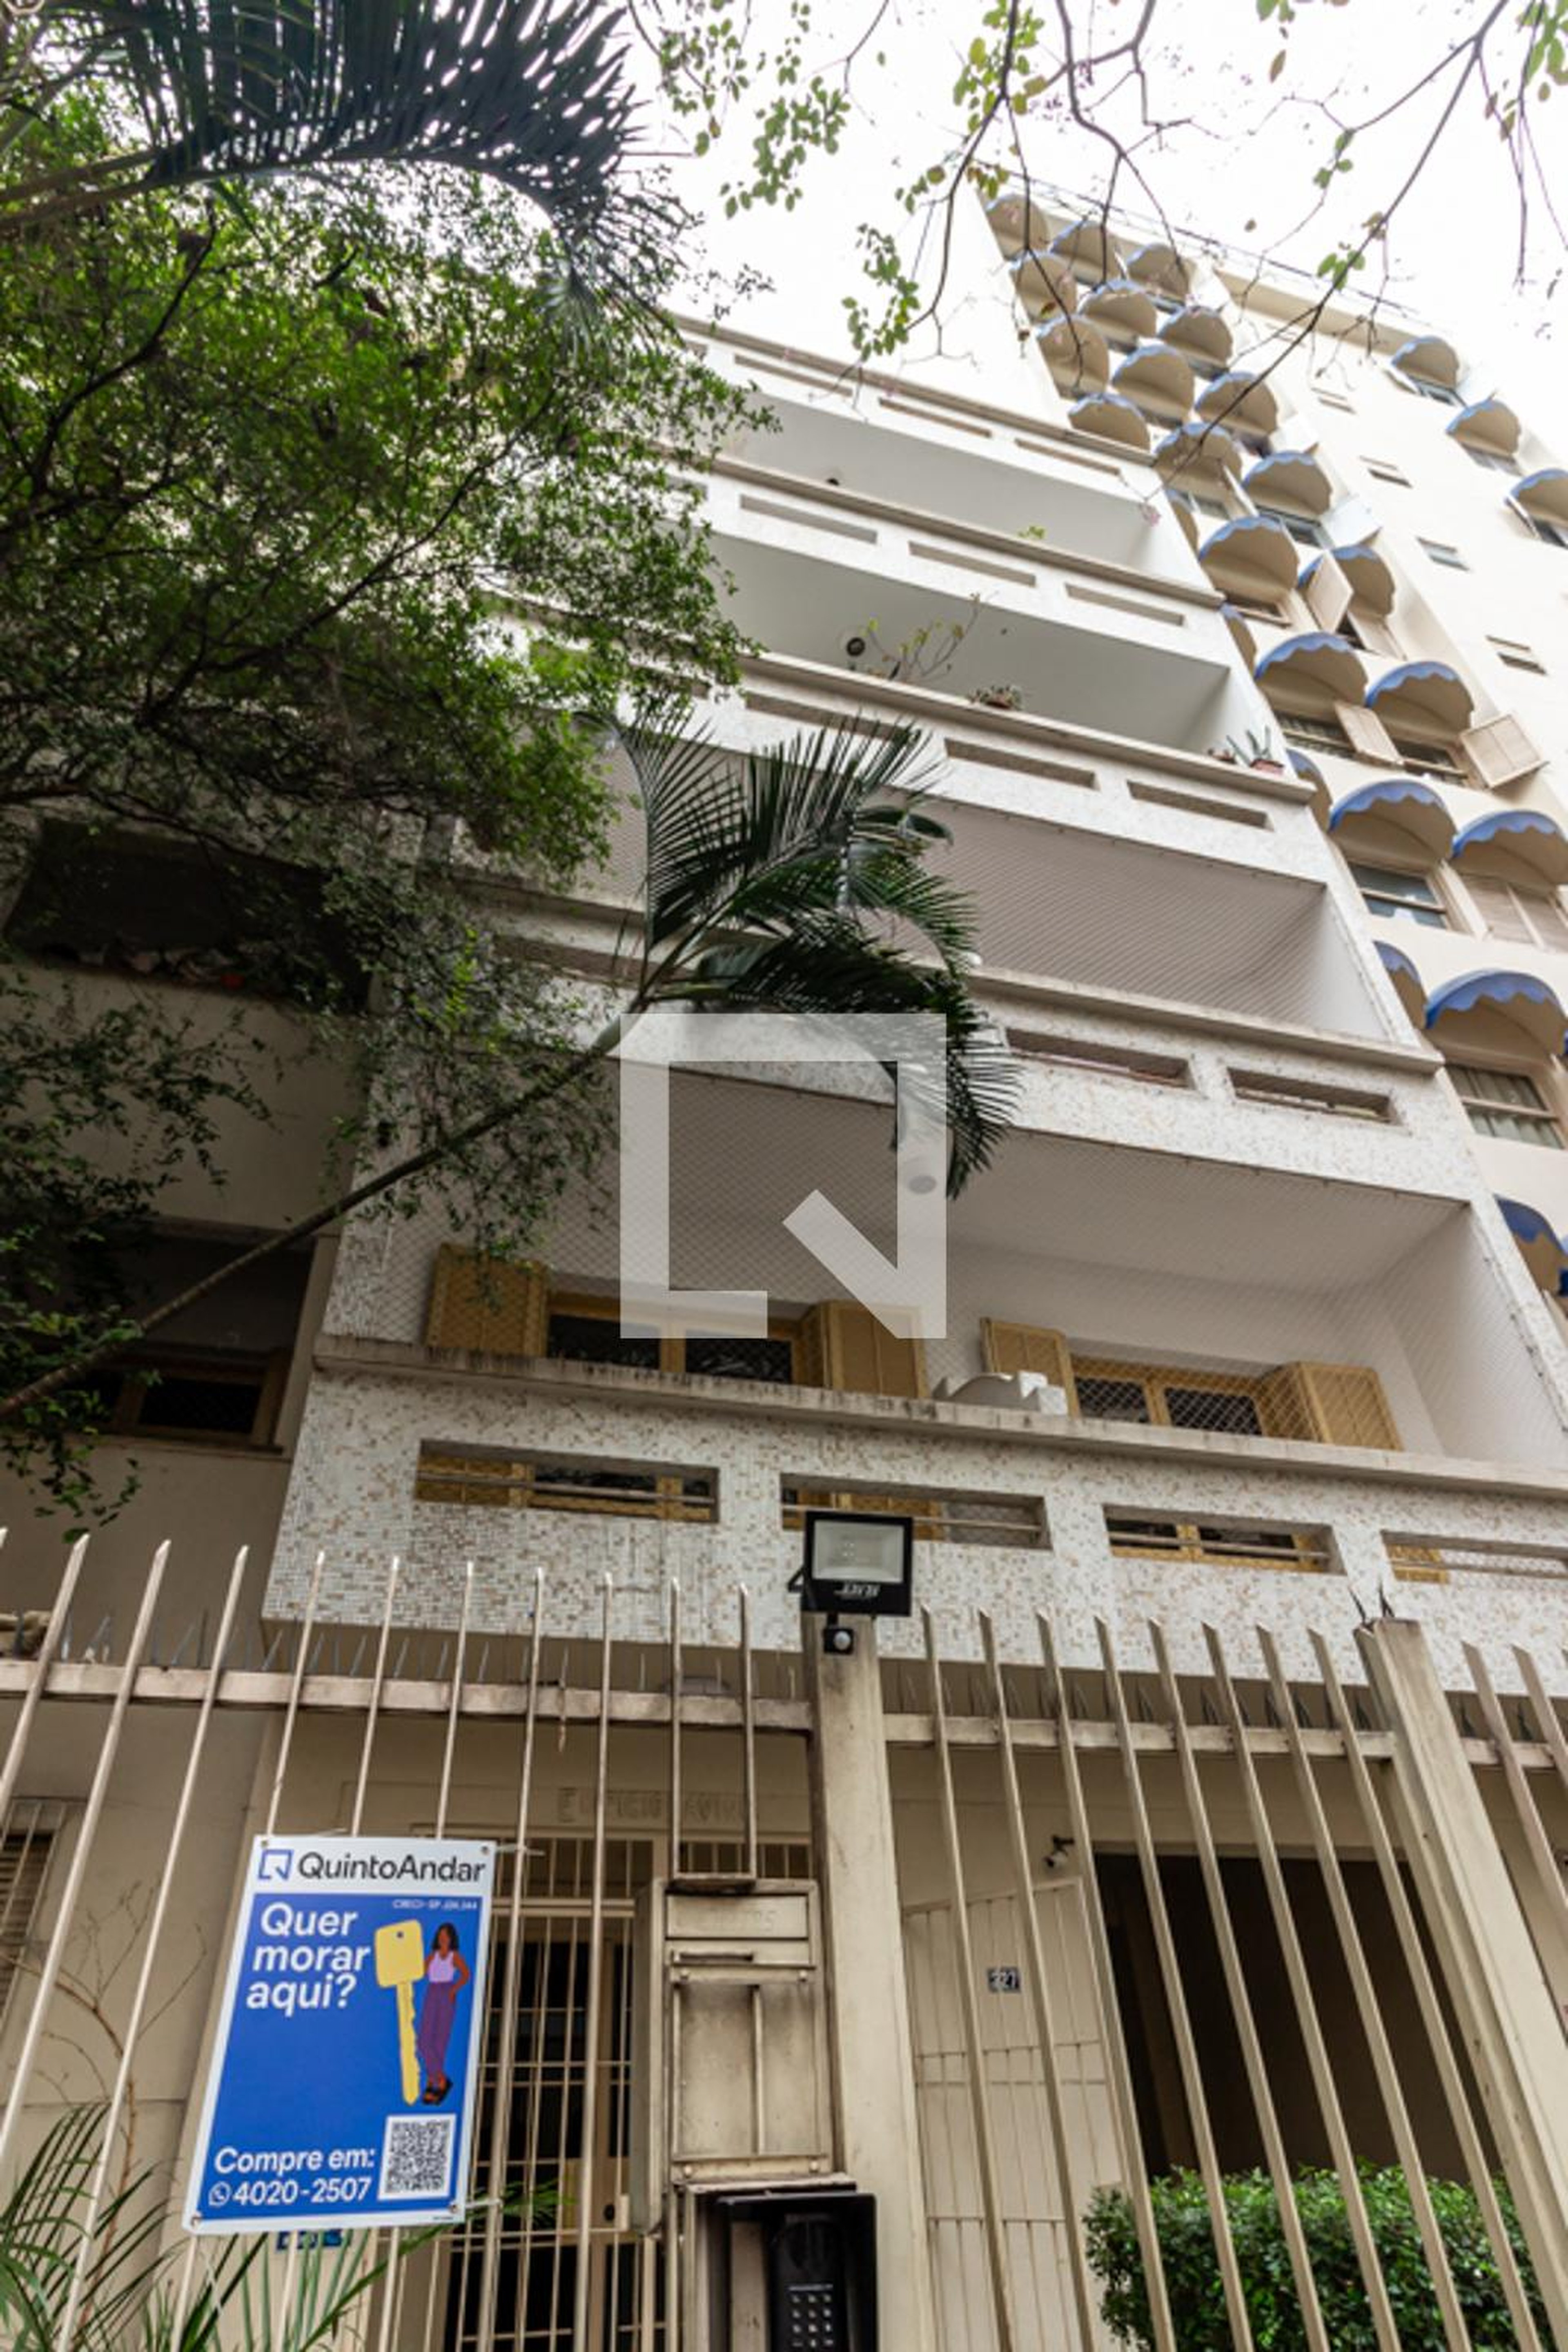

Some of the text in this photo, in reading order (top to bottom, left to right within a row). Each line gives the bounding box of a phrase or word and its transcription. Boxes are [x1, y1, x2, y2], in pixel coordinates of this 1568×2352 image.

[298, 1852, 486, 1882] QuintoAndar
[260, 1901, 359, 1936] Quer
[252, 1945, 371, 1971] morar
[246, 1973, 357, 2017] aqui?
[214, 2146, 375, 2177] Compre em:
[232, 2176, 372, 2205] 4020-2507
